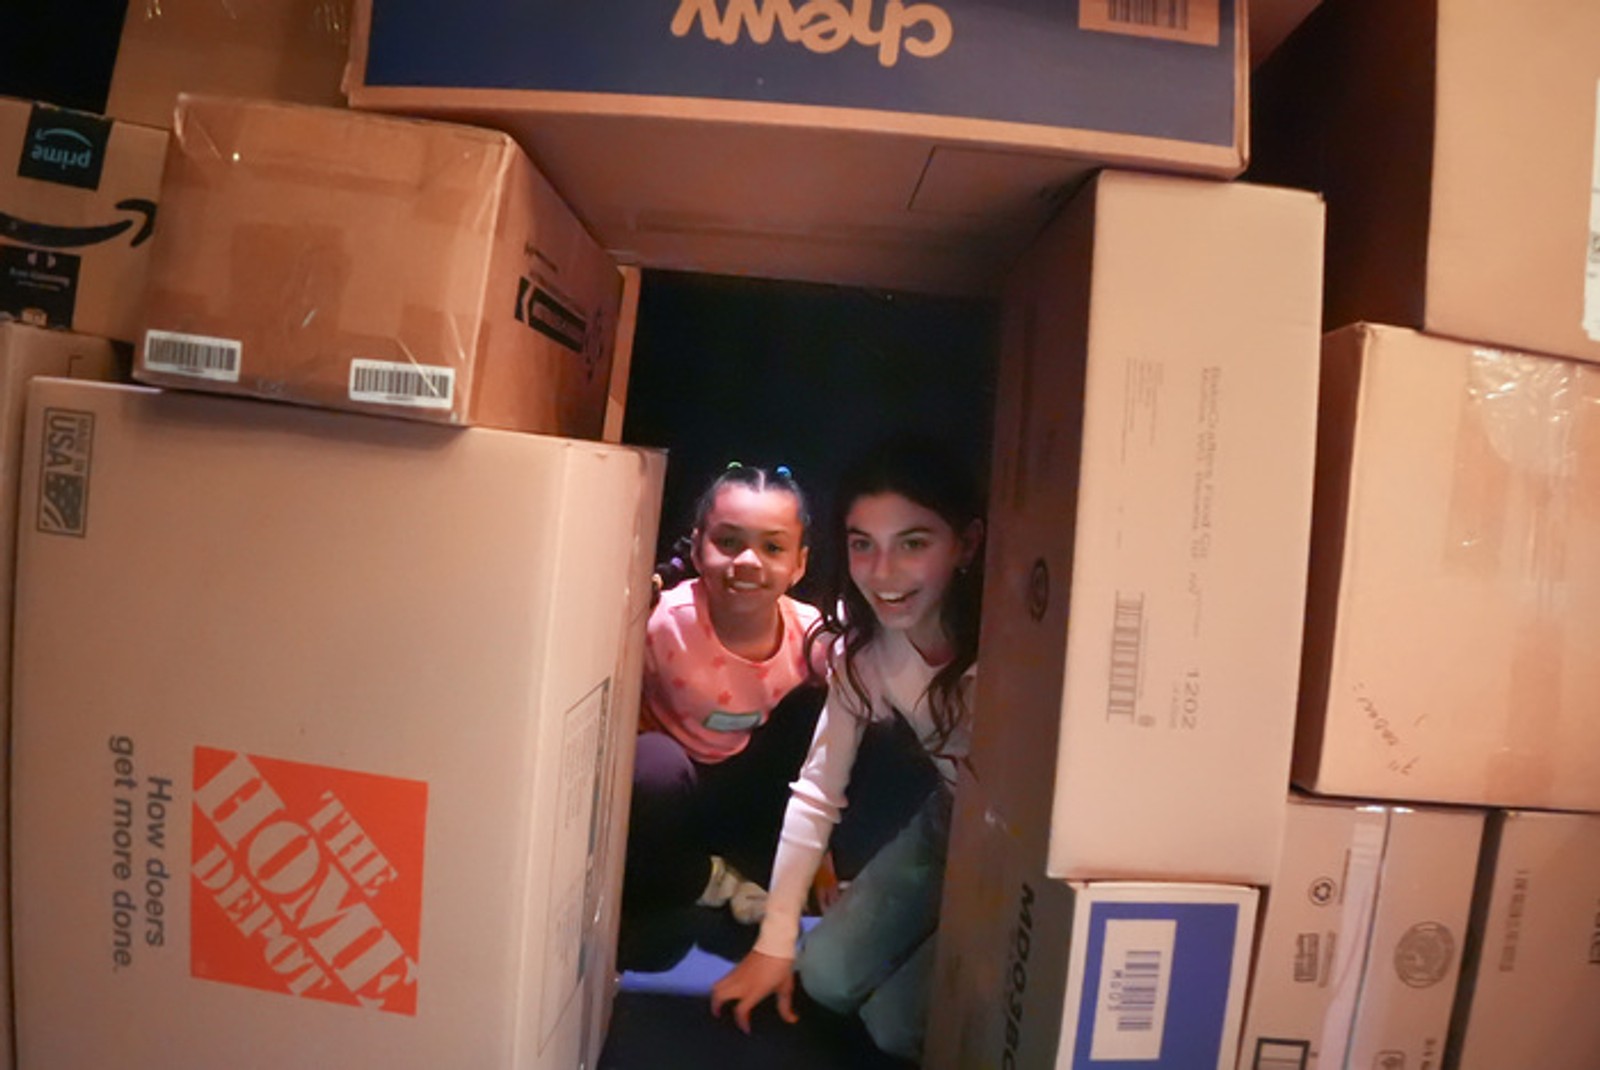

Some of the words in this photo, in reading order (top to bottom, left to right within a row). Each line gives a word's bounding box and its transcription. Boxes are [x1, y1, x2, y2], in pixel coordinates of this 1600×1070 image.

[667, 0, 953, 68] chewy
[30, 142, 92, 172] prime
[47, 415, 77, 468] USA
[1181, 671, 1200, 730] 1202
[108, 735, 138, 789] get
[112, 798, 134, 881] more
[146, 776, 173, 850] How
[306, 790, 399, 898] THE
[144, 858, 171, 947] doers
[192, 750, 419, 1010] HOME
[191, 842, 333, 996] DEPOT
